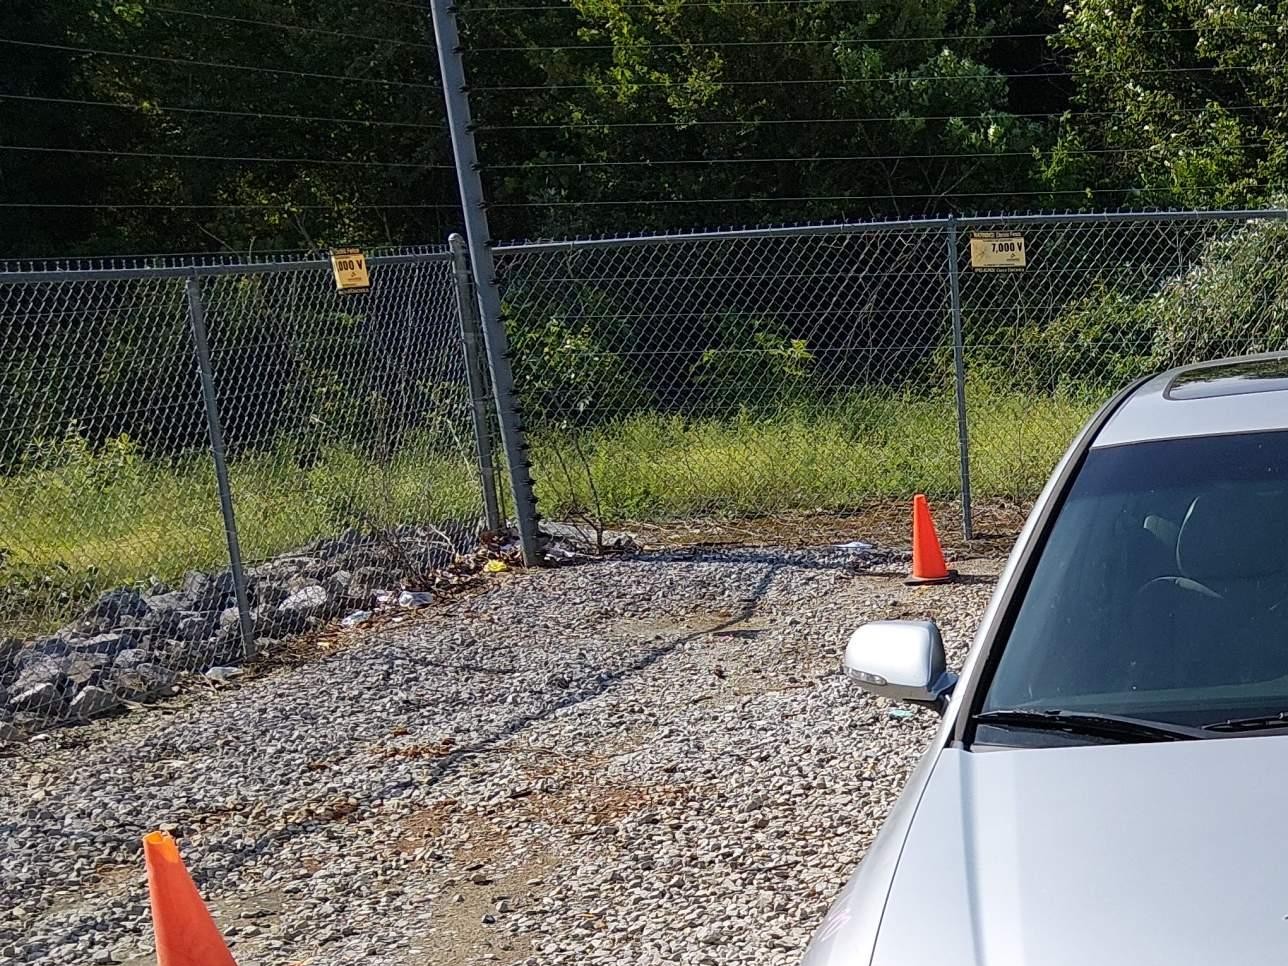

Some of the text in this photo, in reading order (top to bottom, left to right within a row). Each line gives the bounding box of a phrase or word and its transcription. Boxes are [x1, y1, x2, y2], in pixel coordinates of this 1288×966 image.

[992, 242, 1022, 254] 7,000 V
[356, 260, 362, 270] V
